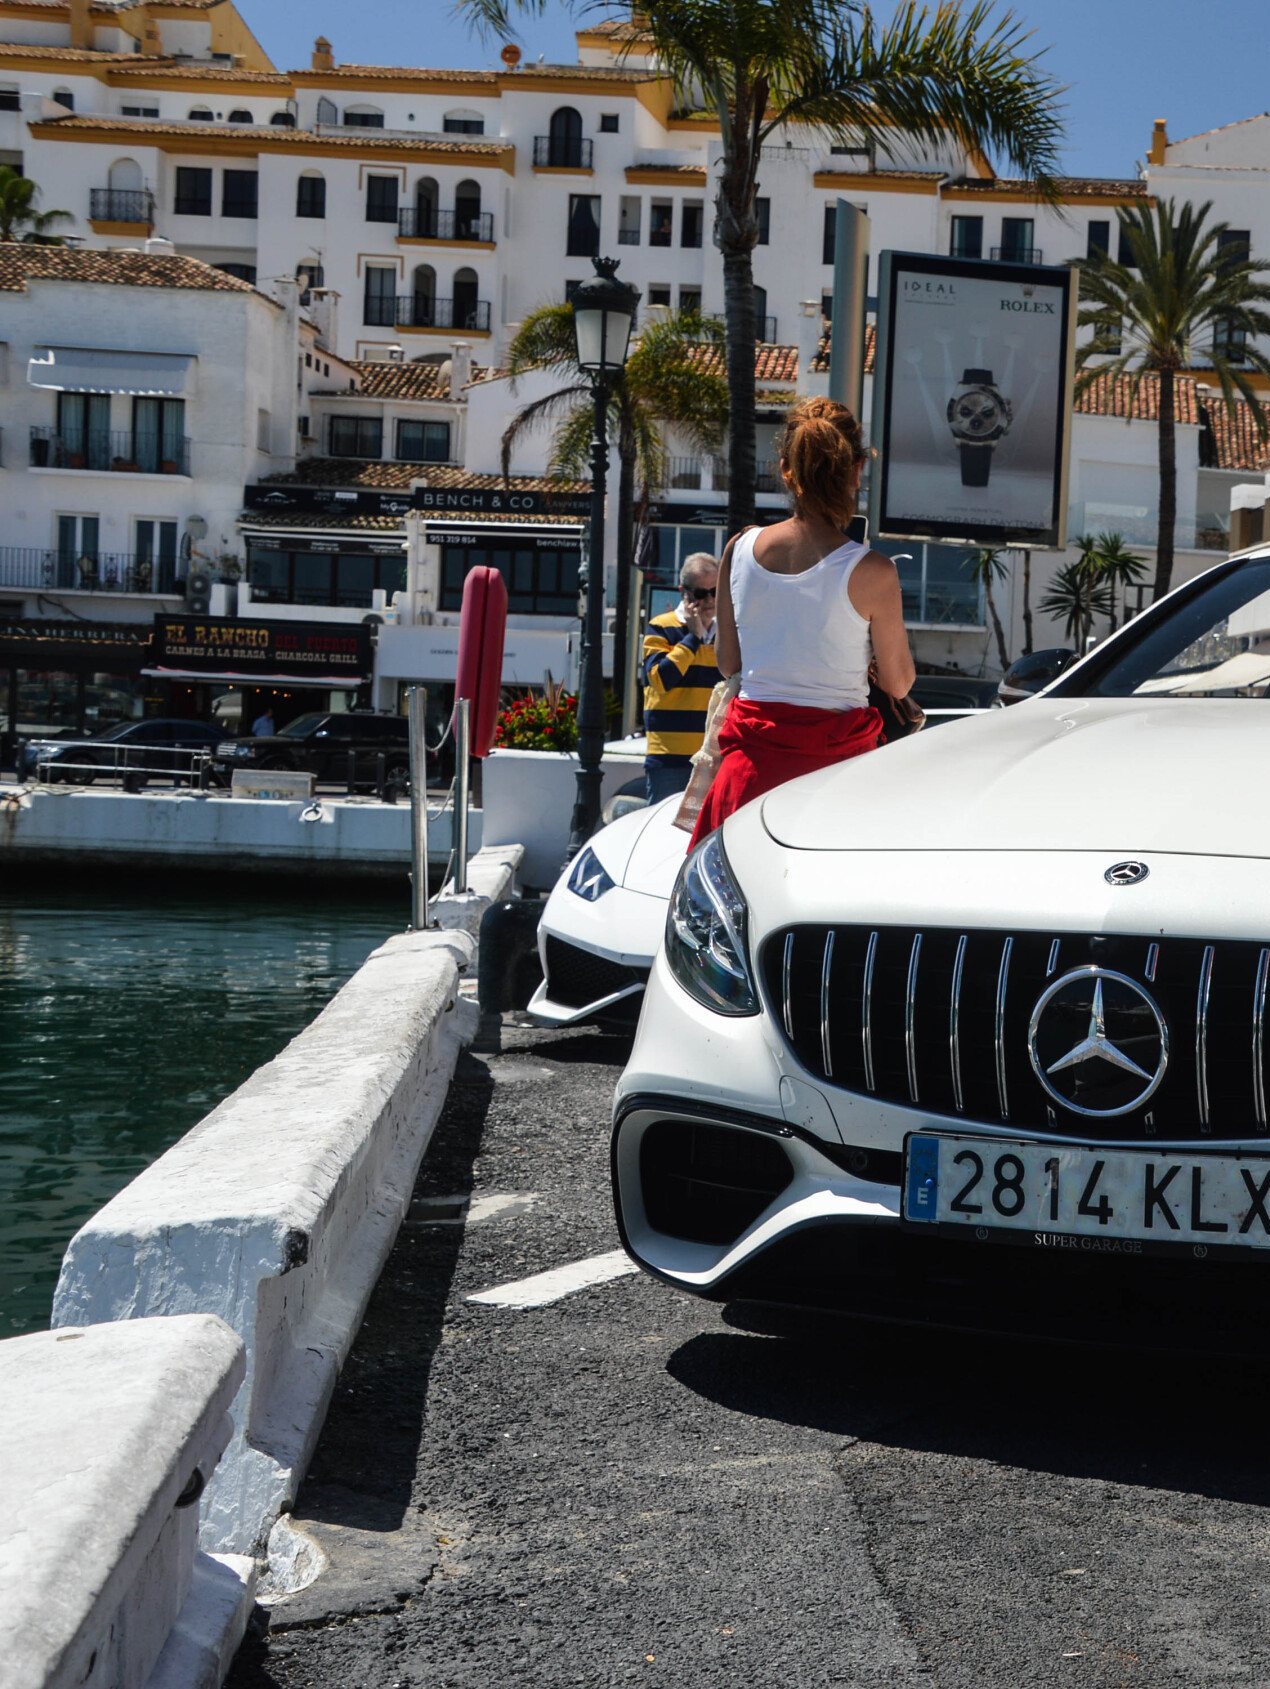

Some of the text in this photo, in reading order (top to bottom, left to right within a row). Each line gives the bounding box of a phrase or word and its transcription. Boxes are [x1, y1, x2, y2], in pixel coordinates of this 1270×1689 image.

[904, 281, 956, 294] IDEAL
[1000, 299, 1055, 314] ROLEX
[423, 493, 483, 506] BENCH
[491, 496, 502, 508] &
[509, 497, 534, 509] CO
[430, 535, 444, 543] 951
[461, 536, 477, 544] 814
[45, 628, 139, 640] HERRERA
[165, 625, 187, 643] EL
[195, 626, 269, 648] RANCHO
[165, 645, 204, 656] CARNES
[207, 647, 215, 657] A
[216, 648, 230, 658] LA
[233, 649, 266, 660] BRASA
[275, 651, 327, 662] CHARCOAL
[329, 653, 358, 664] GRILL
[950, 1149, 1114, 1225] 2814
[917, 1187, 929, 1205] E
[1034, 1232, 1143, 1254] SUPER GARAGE
